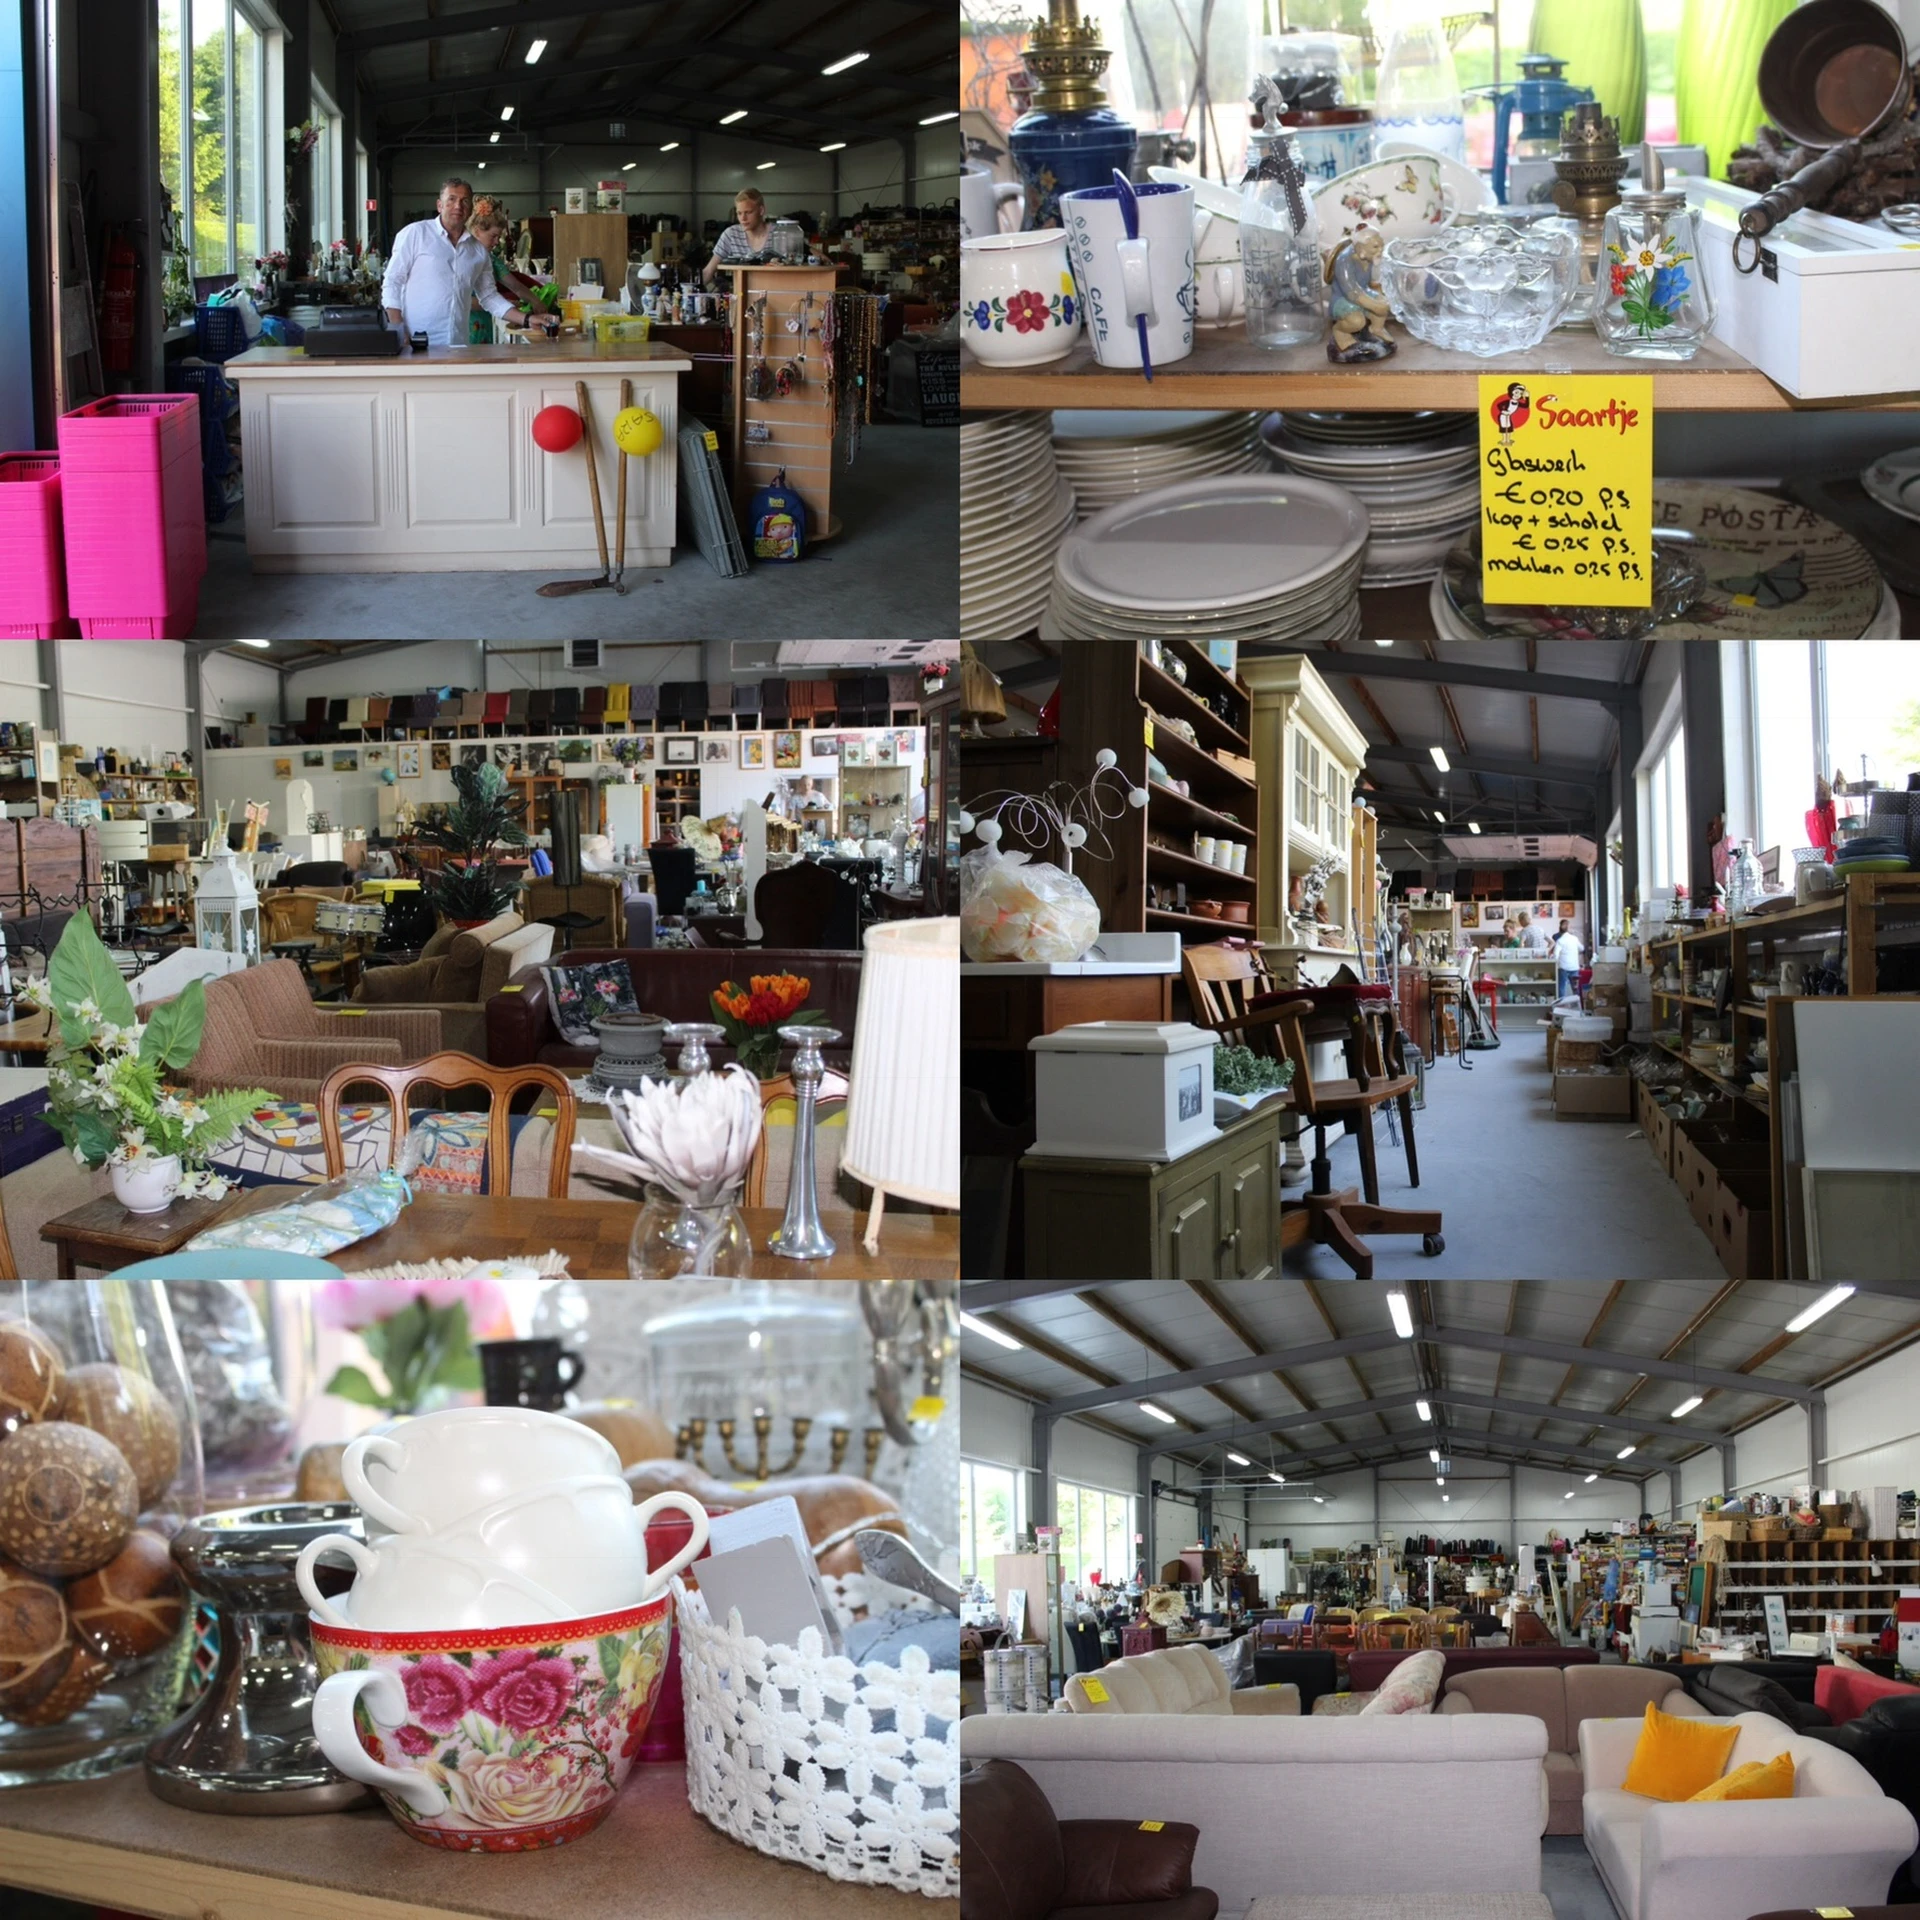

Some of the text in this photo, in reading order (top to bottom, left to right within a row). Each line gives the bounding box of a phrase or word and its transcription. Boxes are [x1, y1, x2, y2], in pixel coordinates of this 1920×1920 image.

[1244, 249, 1276, 267] LET
[1535, 394, 1639, 436] Saartje
[1528, 514, 1540, 527] +
[1548, 510, 1623, 532] schotel
